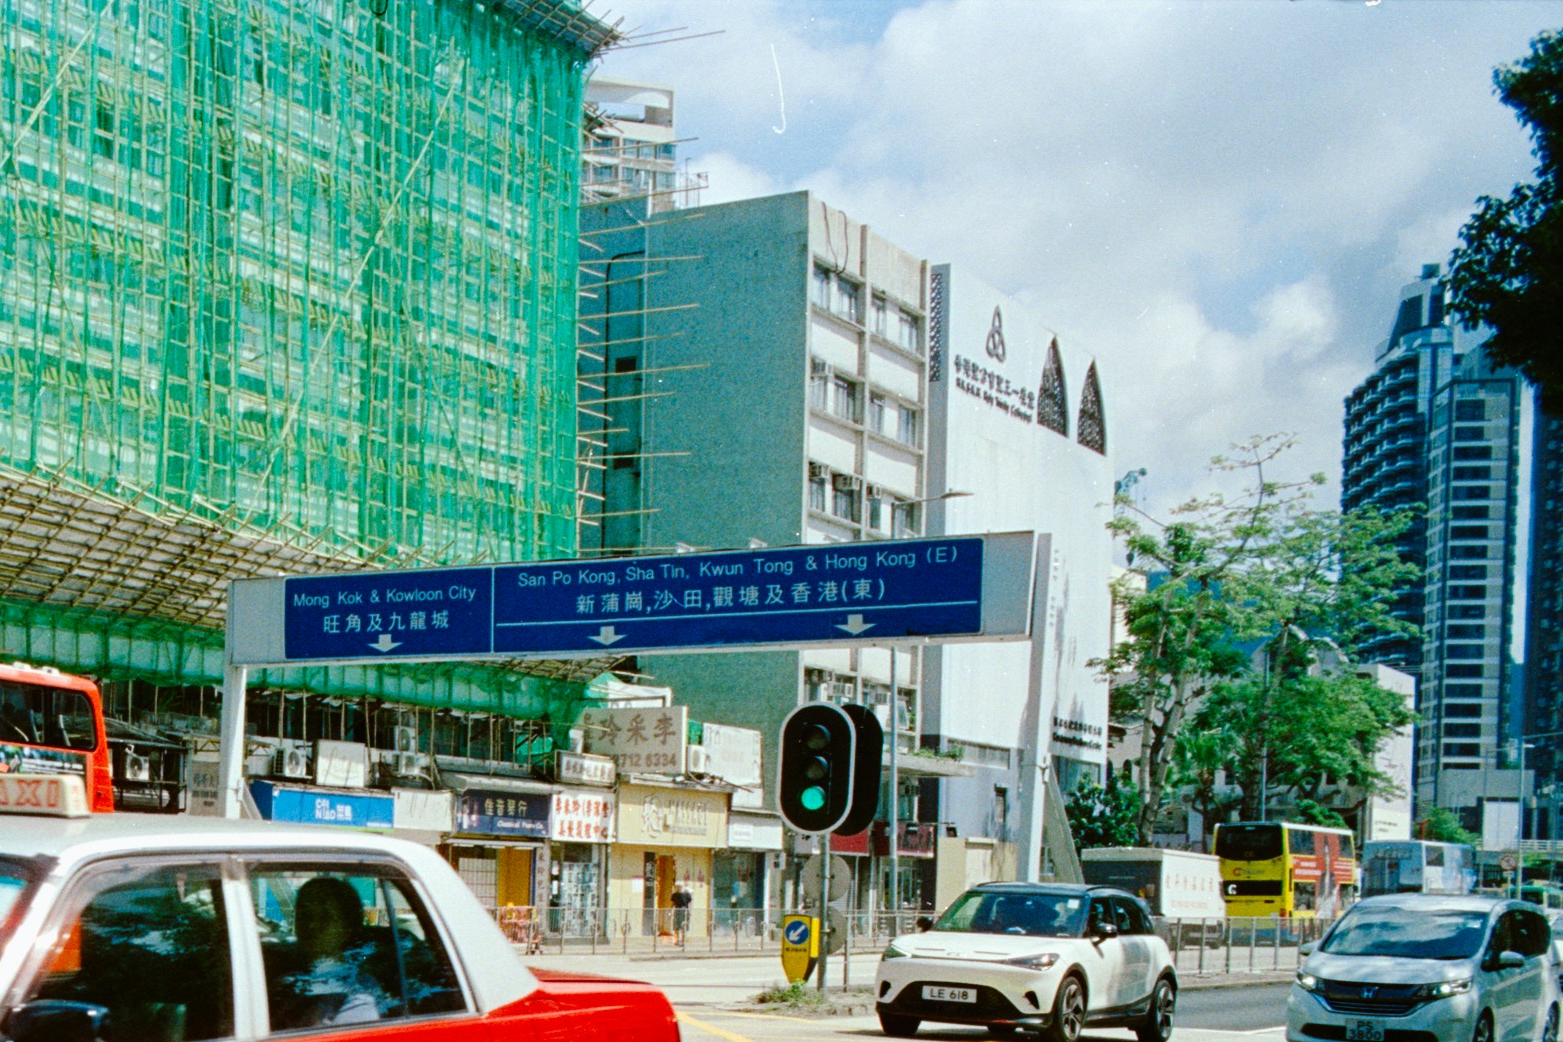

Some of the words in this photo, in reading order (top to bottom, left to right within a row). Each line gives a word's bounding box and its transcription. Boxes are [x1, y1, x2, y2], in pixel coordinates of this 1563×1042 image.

[518, 572, 546, 587] San
[552, 571, 572, 585] Po
[626, 566, 655, 581] Sha
[699, 561, 744, 577] Kwun
[753, 558, 793, 575] Tong
[805, 555, 818, 571] &
[825, 553, 867, 571] Hong
[876, 551, 916, 567] Kong
[926, 546, 958, 564] (E)
[293, 593, 330, 608] Mong
[337, 591, 363, 604] Kok
[370, 589, 381, 603] &
[386, 588, 443, 603] Kowloon
[448, 585, 476, 602] City
[323, 610, 449, 634] 旺角及九龍城
[645, 752, 677, 768] 6334
[930, 988, 945, 999] LE
[949, 989, 969, 1000] 618
